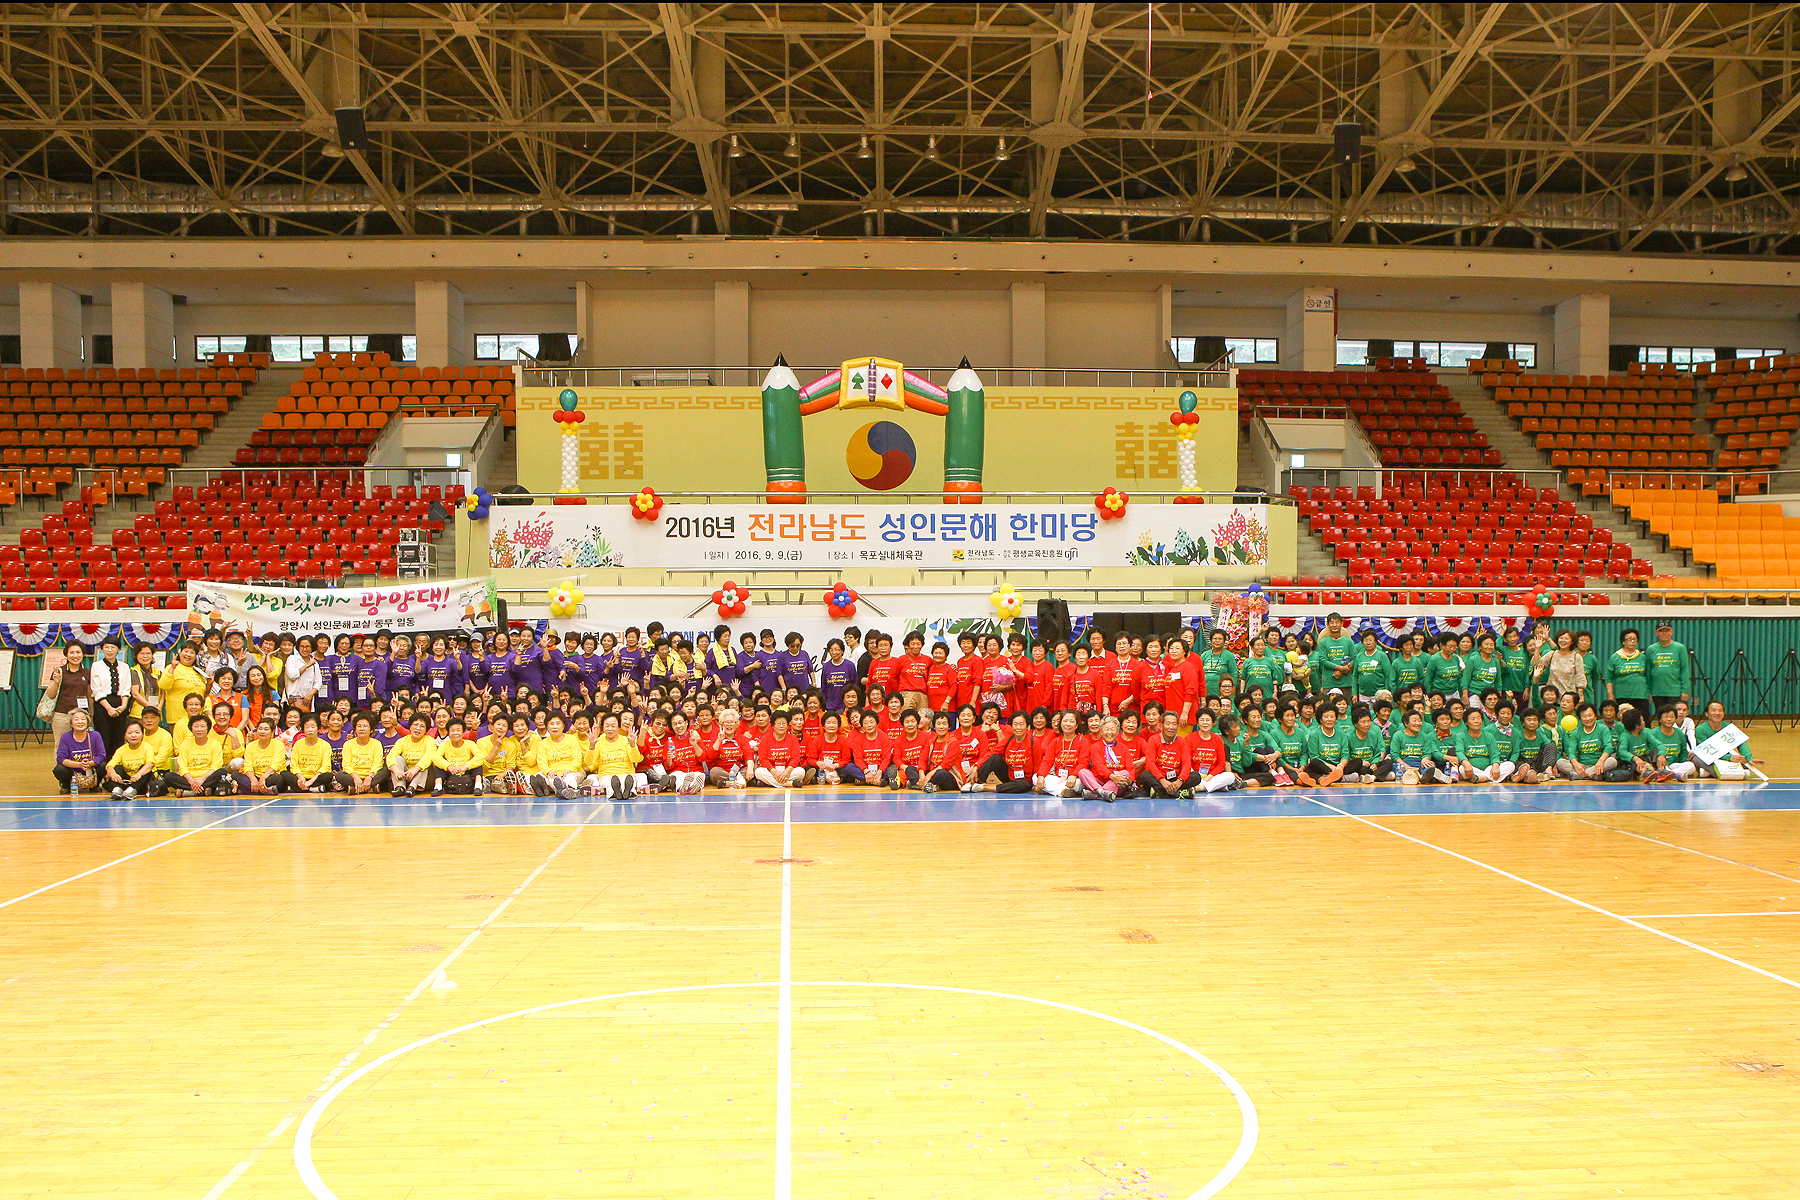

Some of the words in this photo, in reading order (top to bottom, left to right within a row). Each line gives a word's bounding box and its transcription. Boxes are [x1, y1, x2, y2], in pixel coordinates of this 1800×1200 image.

[665, 516, 736, 539] 2016년
[748, 513, 867, 542] 전라남도
[879, 513, 997, 542] 성인문해
[1010, 513, 1099, 542] 한마당
[735, 551, 762, 560] 2016.
[859, 550, 923, 561] 목포실내체육관
[967, 549, 995, 557] 전라남도
[1012, 549, 1063, 558] 평생교육진흥원
[359, 586, 450, 616] 광양댁!
[279, 620, 309, 631] 광양시
[313, 618, 371, 630] 성인문해교실
[396, 617, 416, 628] 일동
